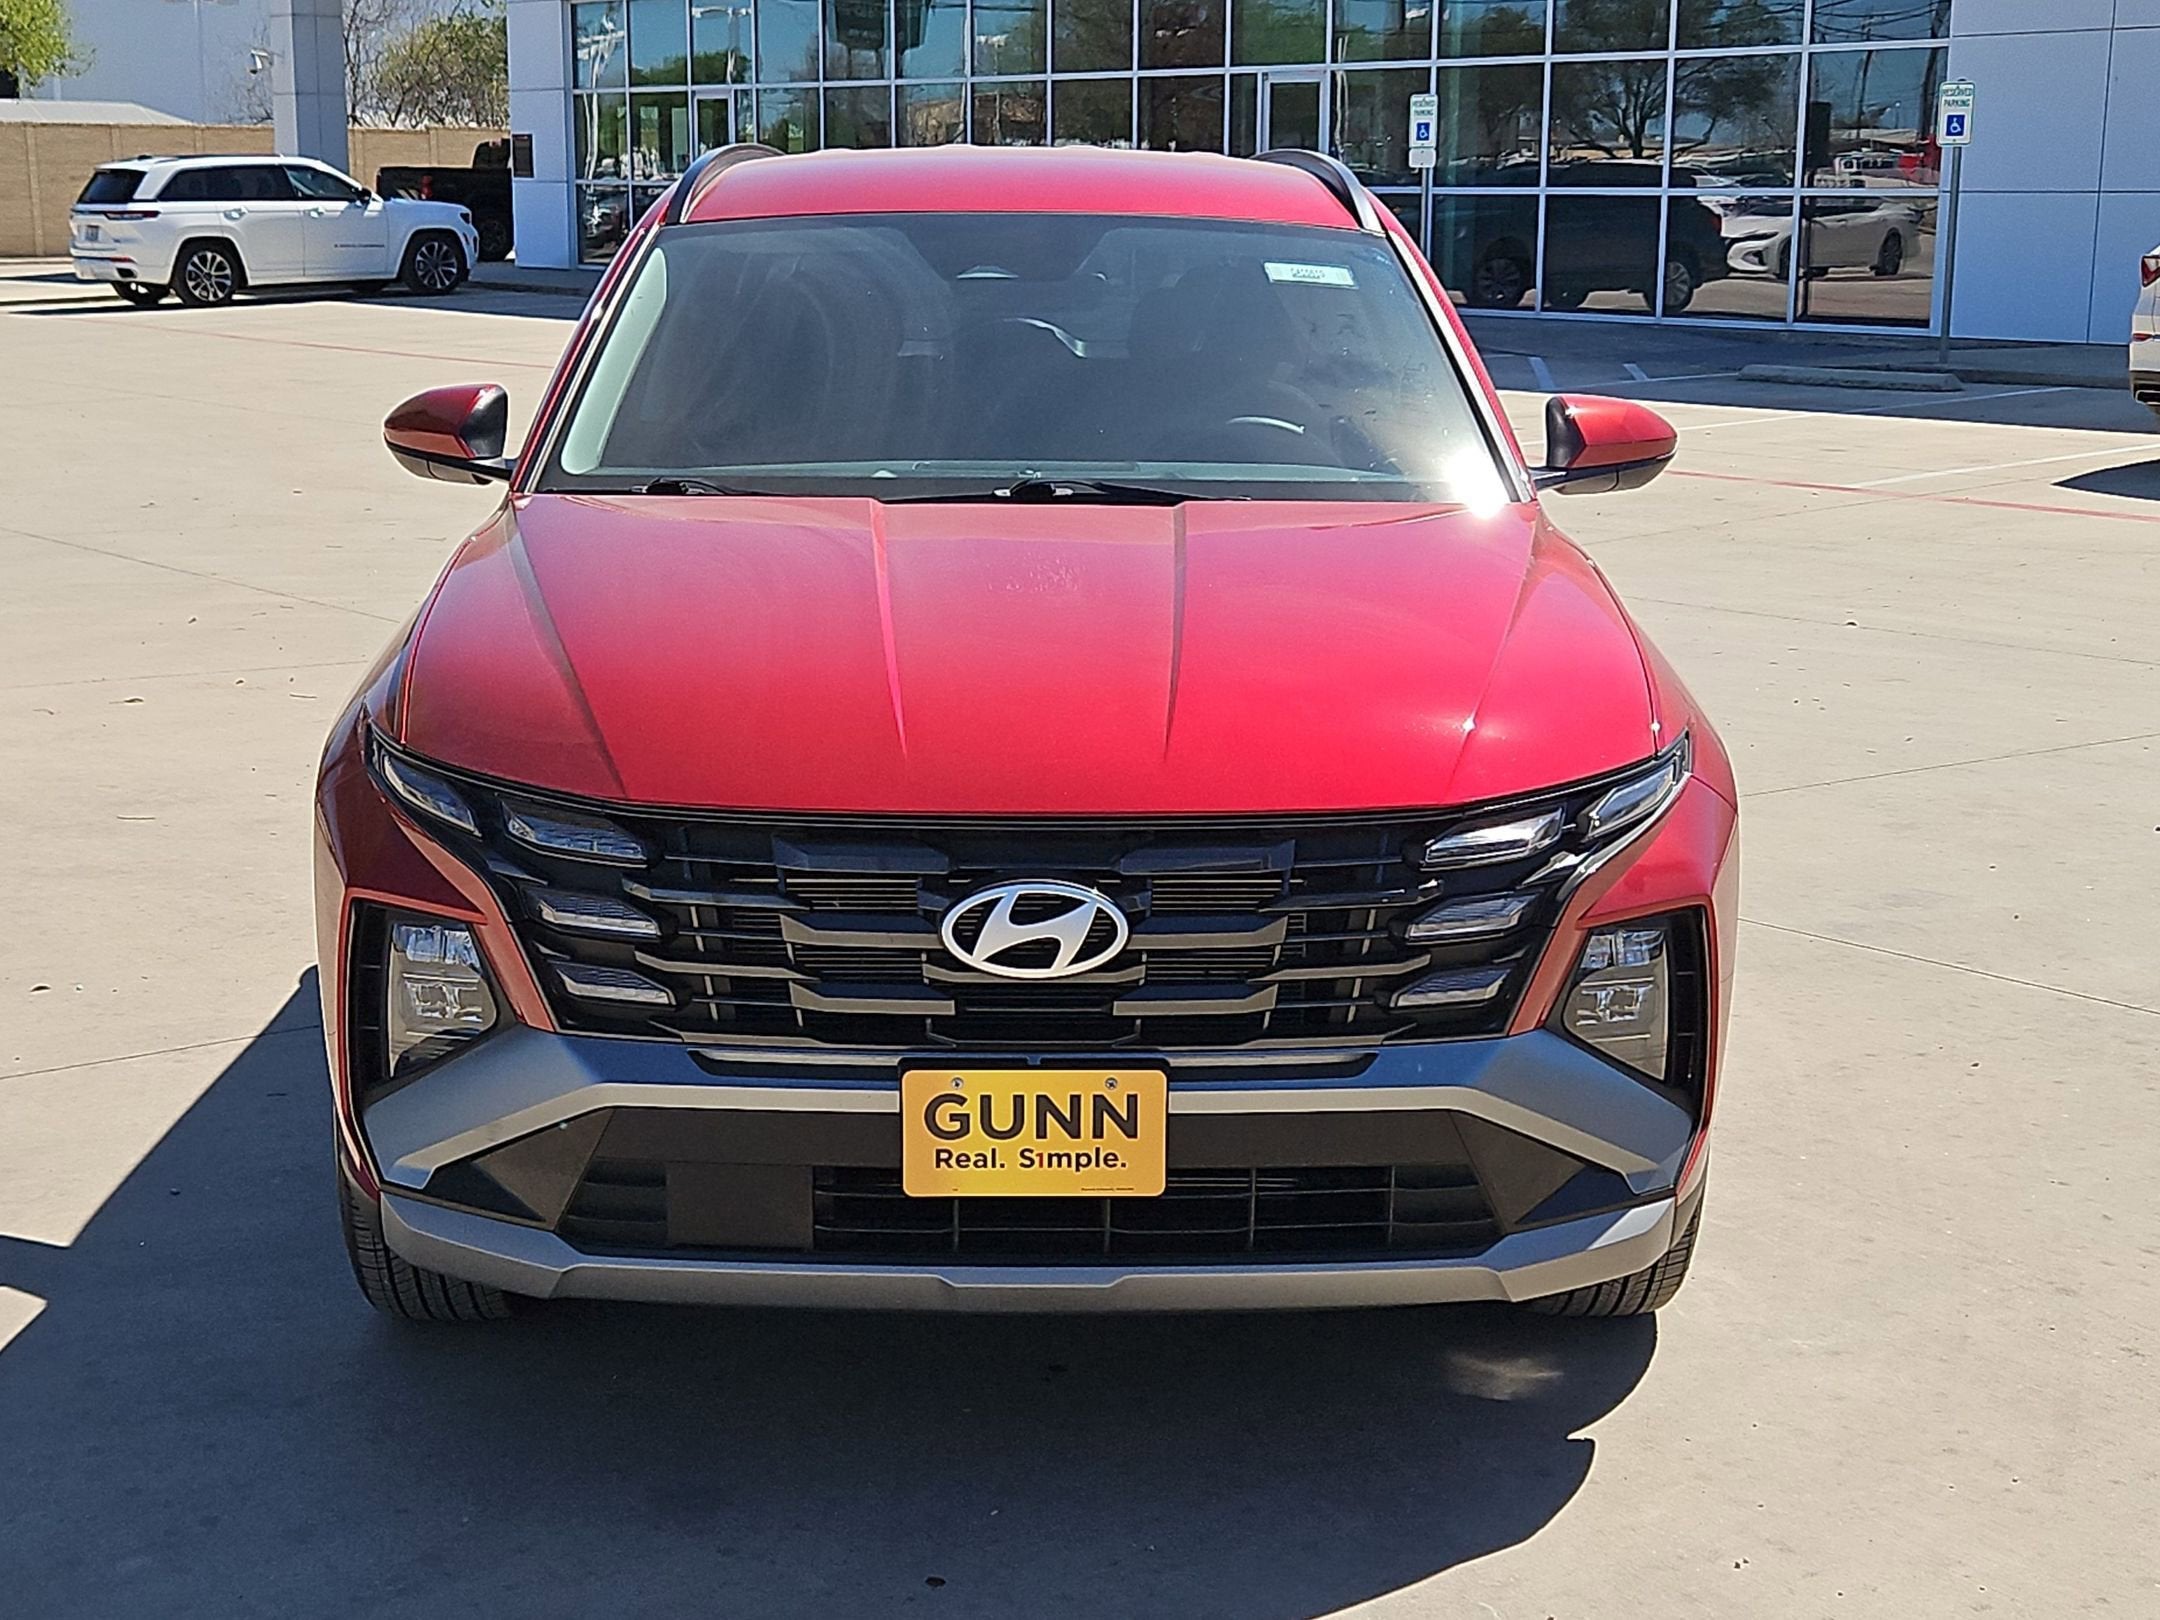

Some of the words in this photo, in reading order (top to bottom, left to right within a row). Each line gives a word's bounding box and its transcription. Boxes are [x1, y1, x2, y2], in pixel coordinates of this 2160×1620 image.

[1943, 99, 1971, 107] PARKING
[923, 1093, 1139, 1140] GUNN
[935, 1148, 1006, 1169] Real.
